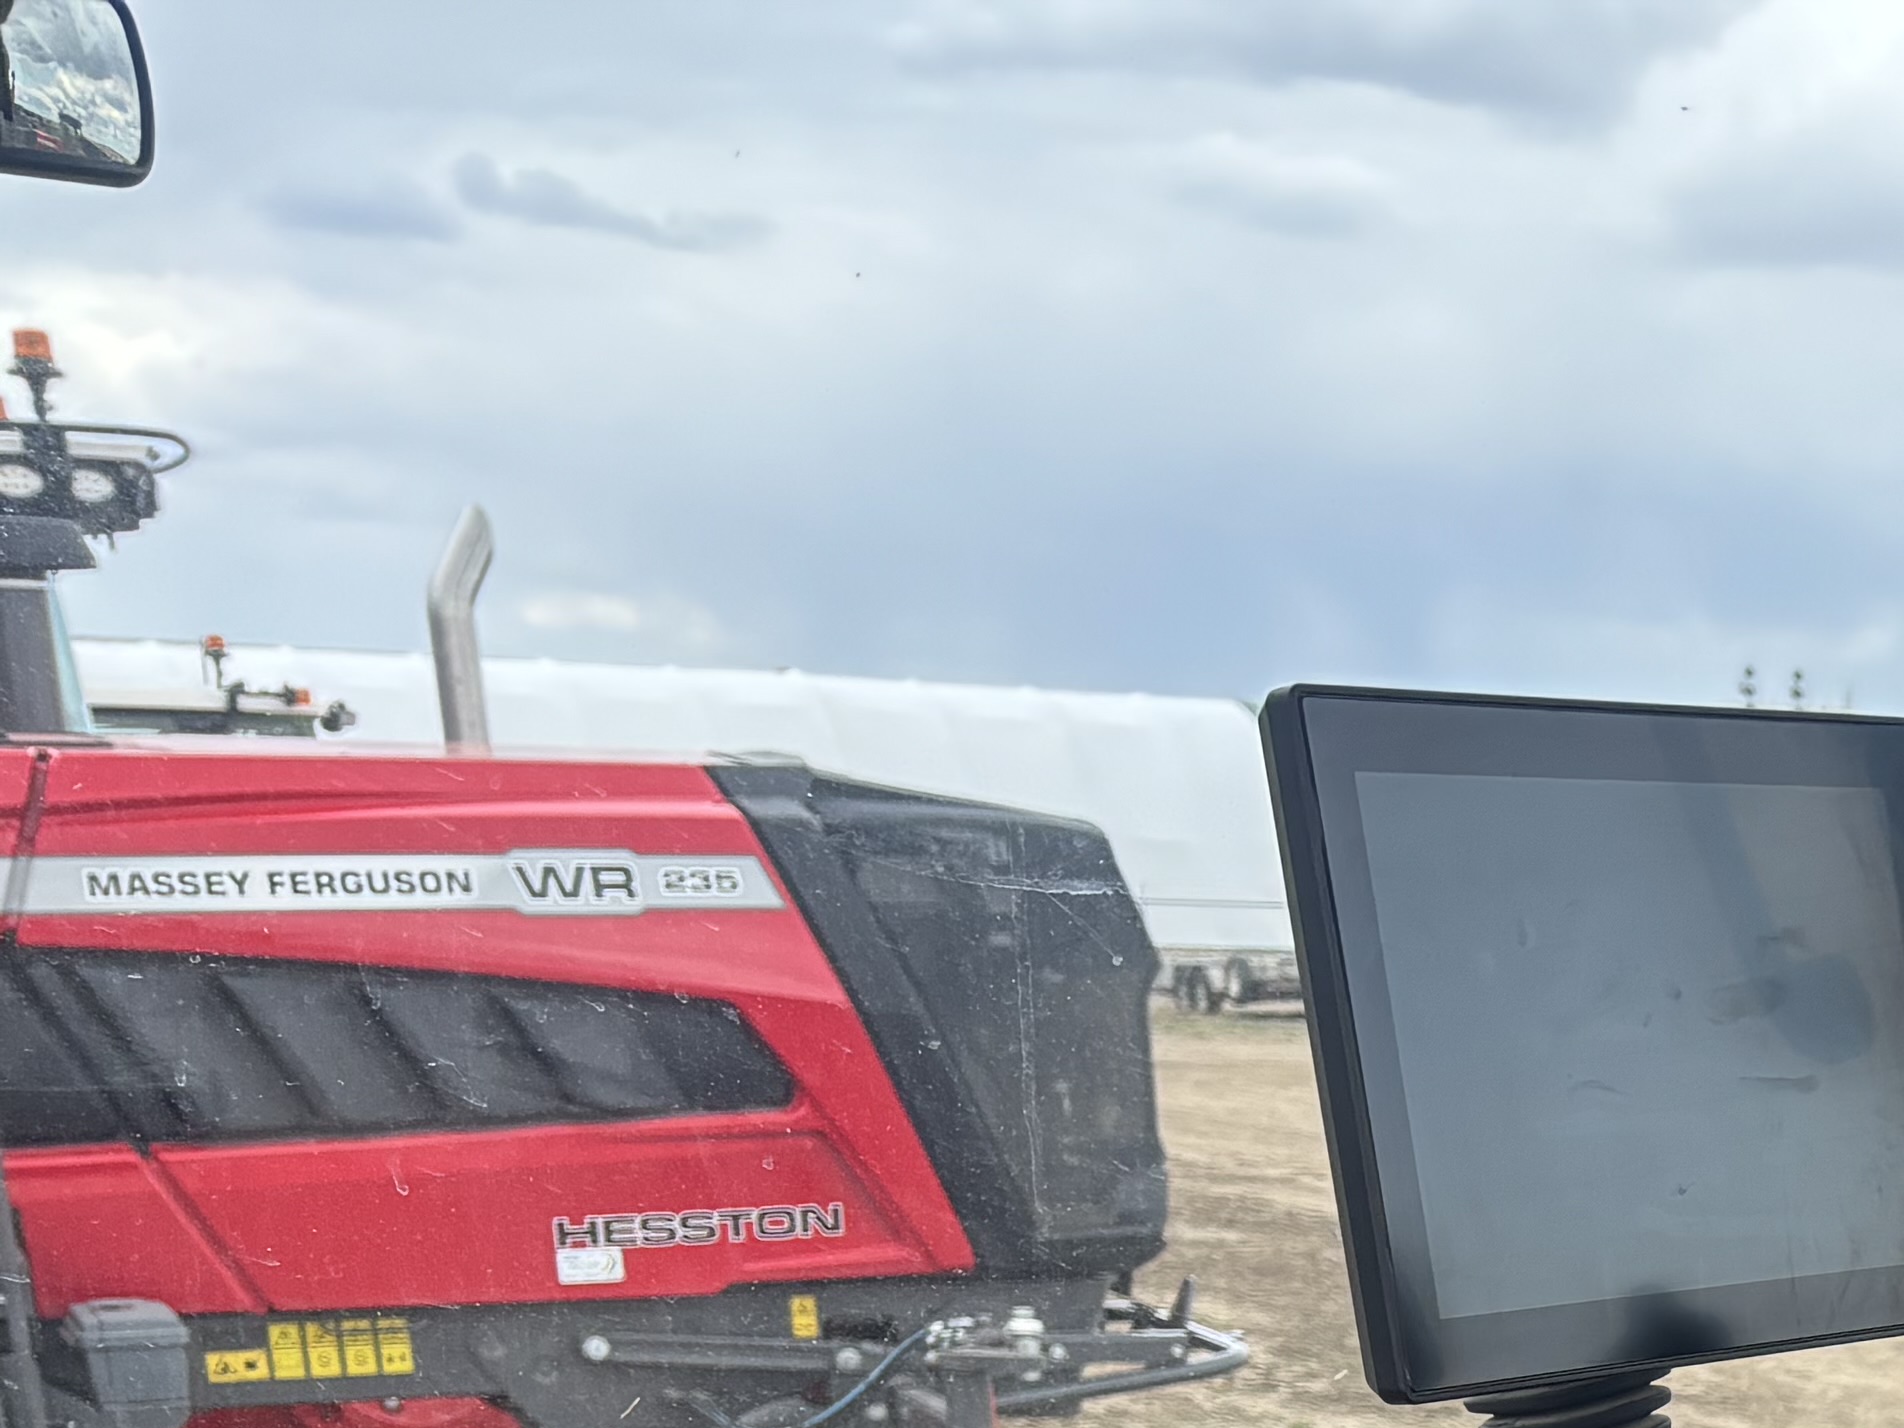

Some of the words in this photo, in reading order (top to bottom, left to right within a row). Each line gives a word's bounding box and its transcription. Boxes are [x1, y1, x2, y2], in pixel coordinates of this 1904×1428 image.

[85, 870, 250, 897] MASSEY
[266, 869, 474, 896] FERGUSON
[510, 863, 639, 900] WR
[661, 868, 739, 894] 235
[554, 1203, 843, 1248] HESSTON
